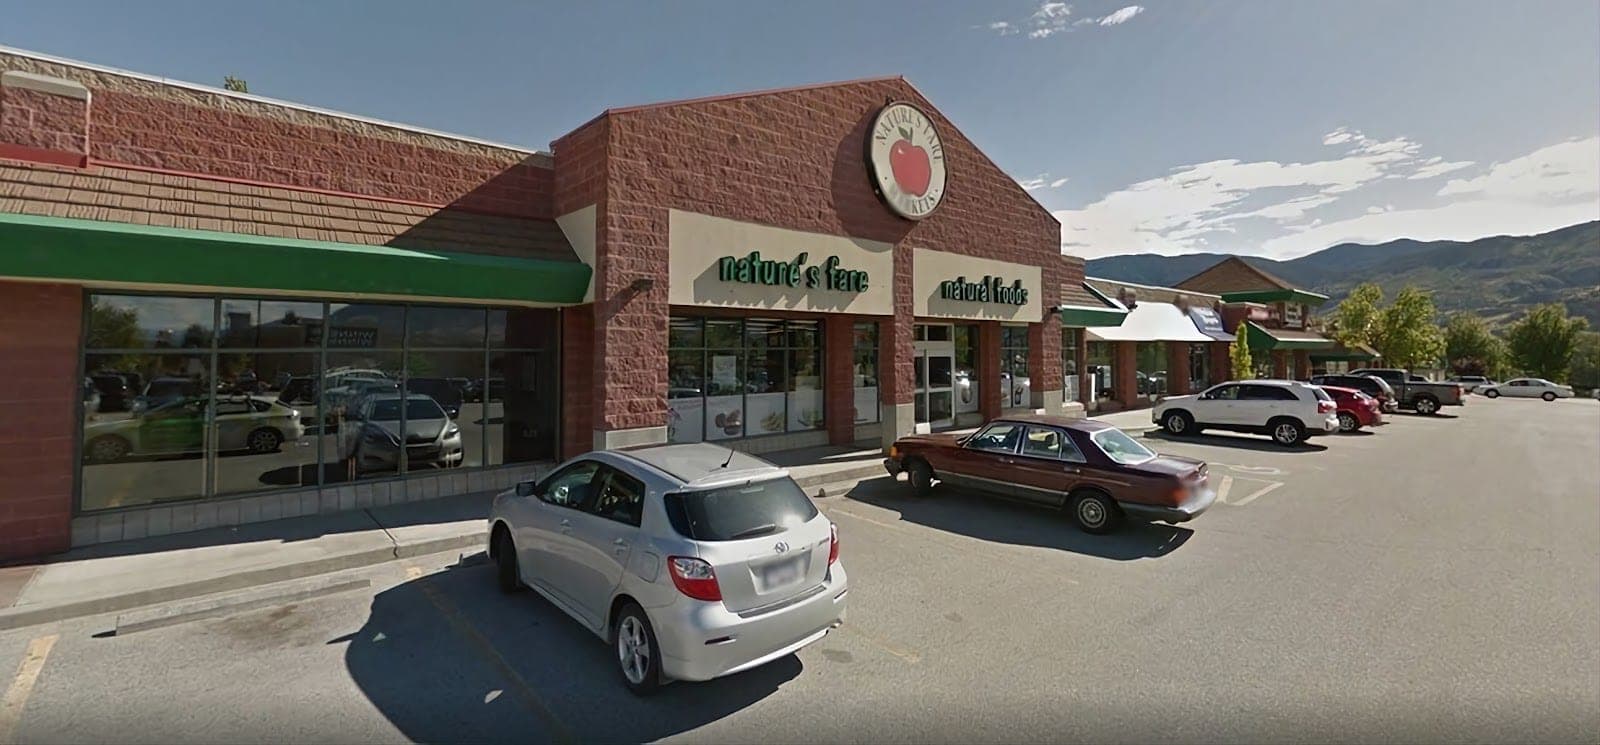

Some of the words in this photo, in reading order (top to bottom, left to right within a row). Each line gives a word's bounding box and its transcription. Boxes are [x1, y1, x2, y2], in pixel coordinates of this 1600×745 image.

[719, 251, 820, 288] nature's
[826, 256, 869, 293] fare
[941, 275, 992, 302] natural
[993, 277, 1028, 305] foods
